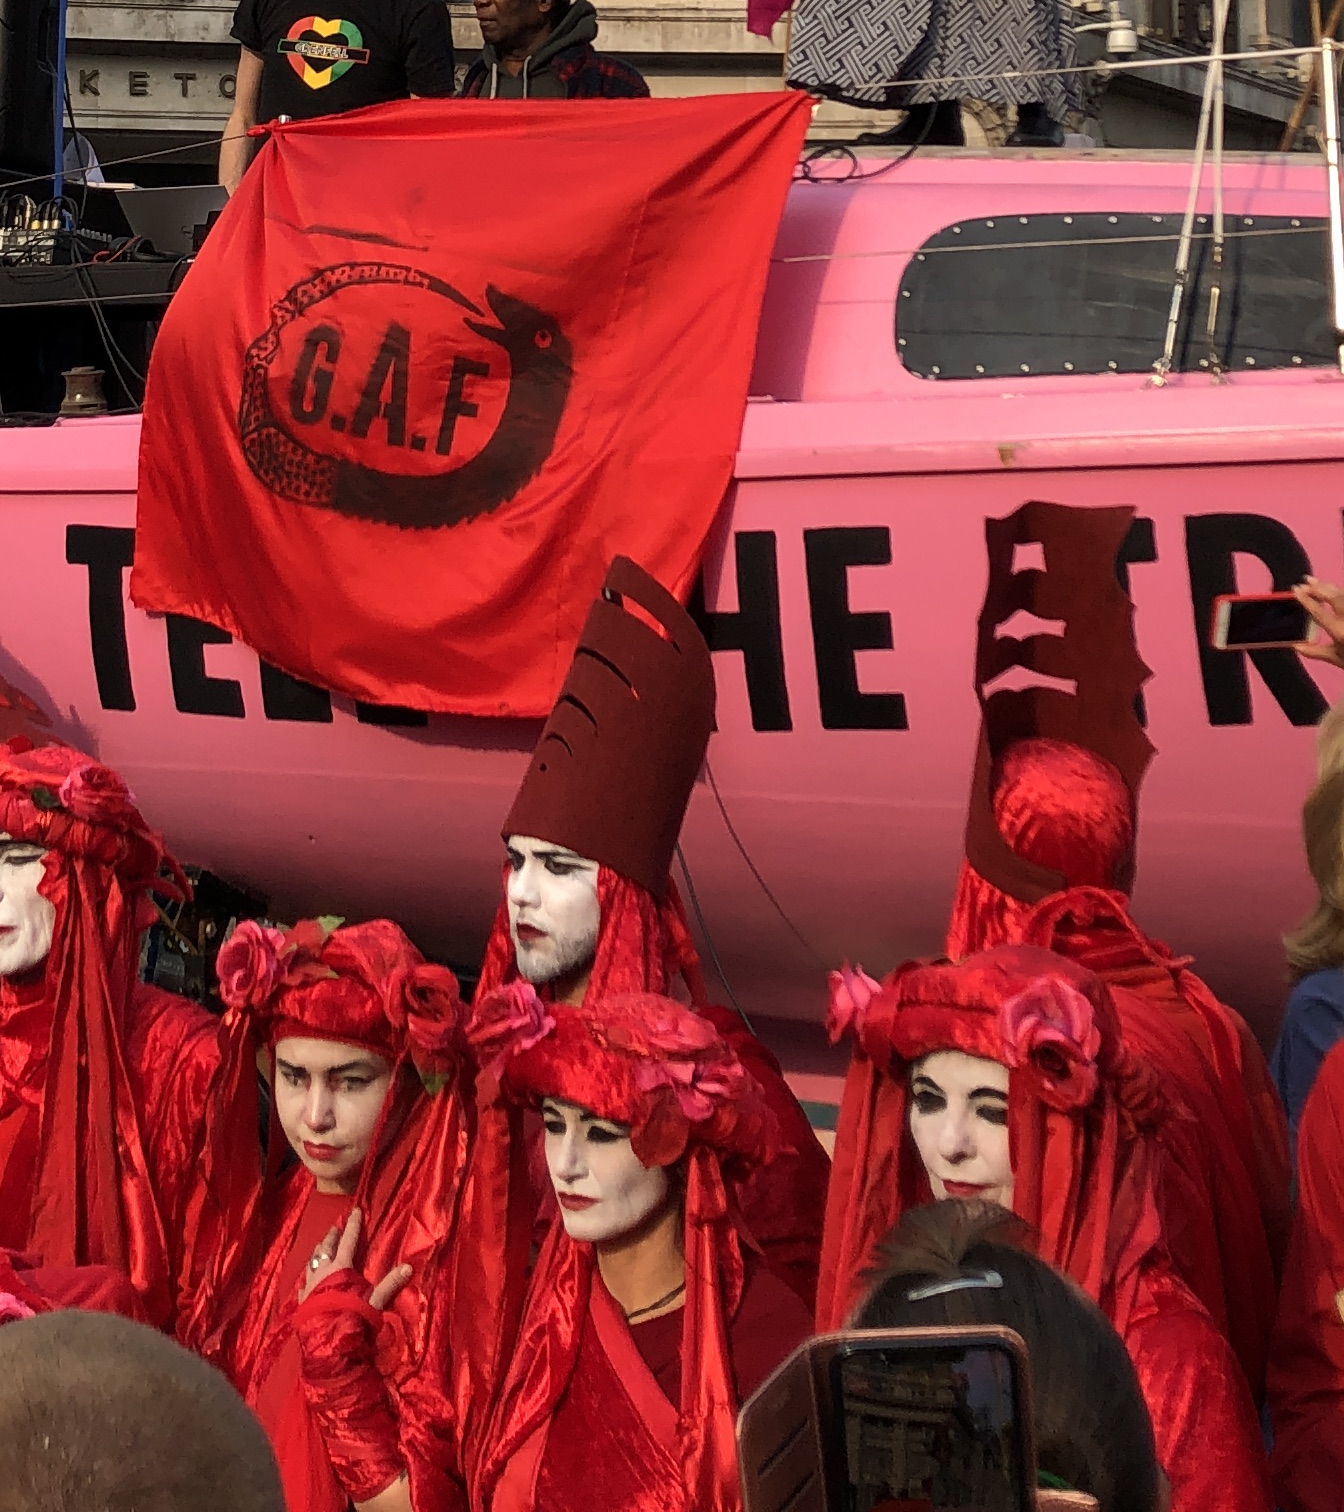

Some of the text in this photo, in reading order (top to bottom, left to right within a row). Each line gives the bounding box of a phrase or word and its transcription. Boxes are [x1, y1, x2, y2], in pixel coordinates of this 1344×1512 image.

[79, 69, 237, 99] KETO
[289, 321, 490, 457] G.A.F
[687, 526, 909, 733] HE
